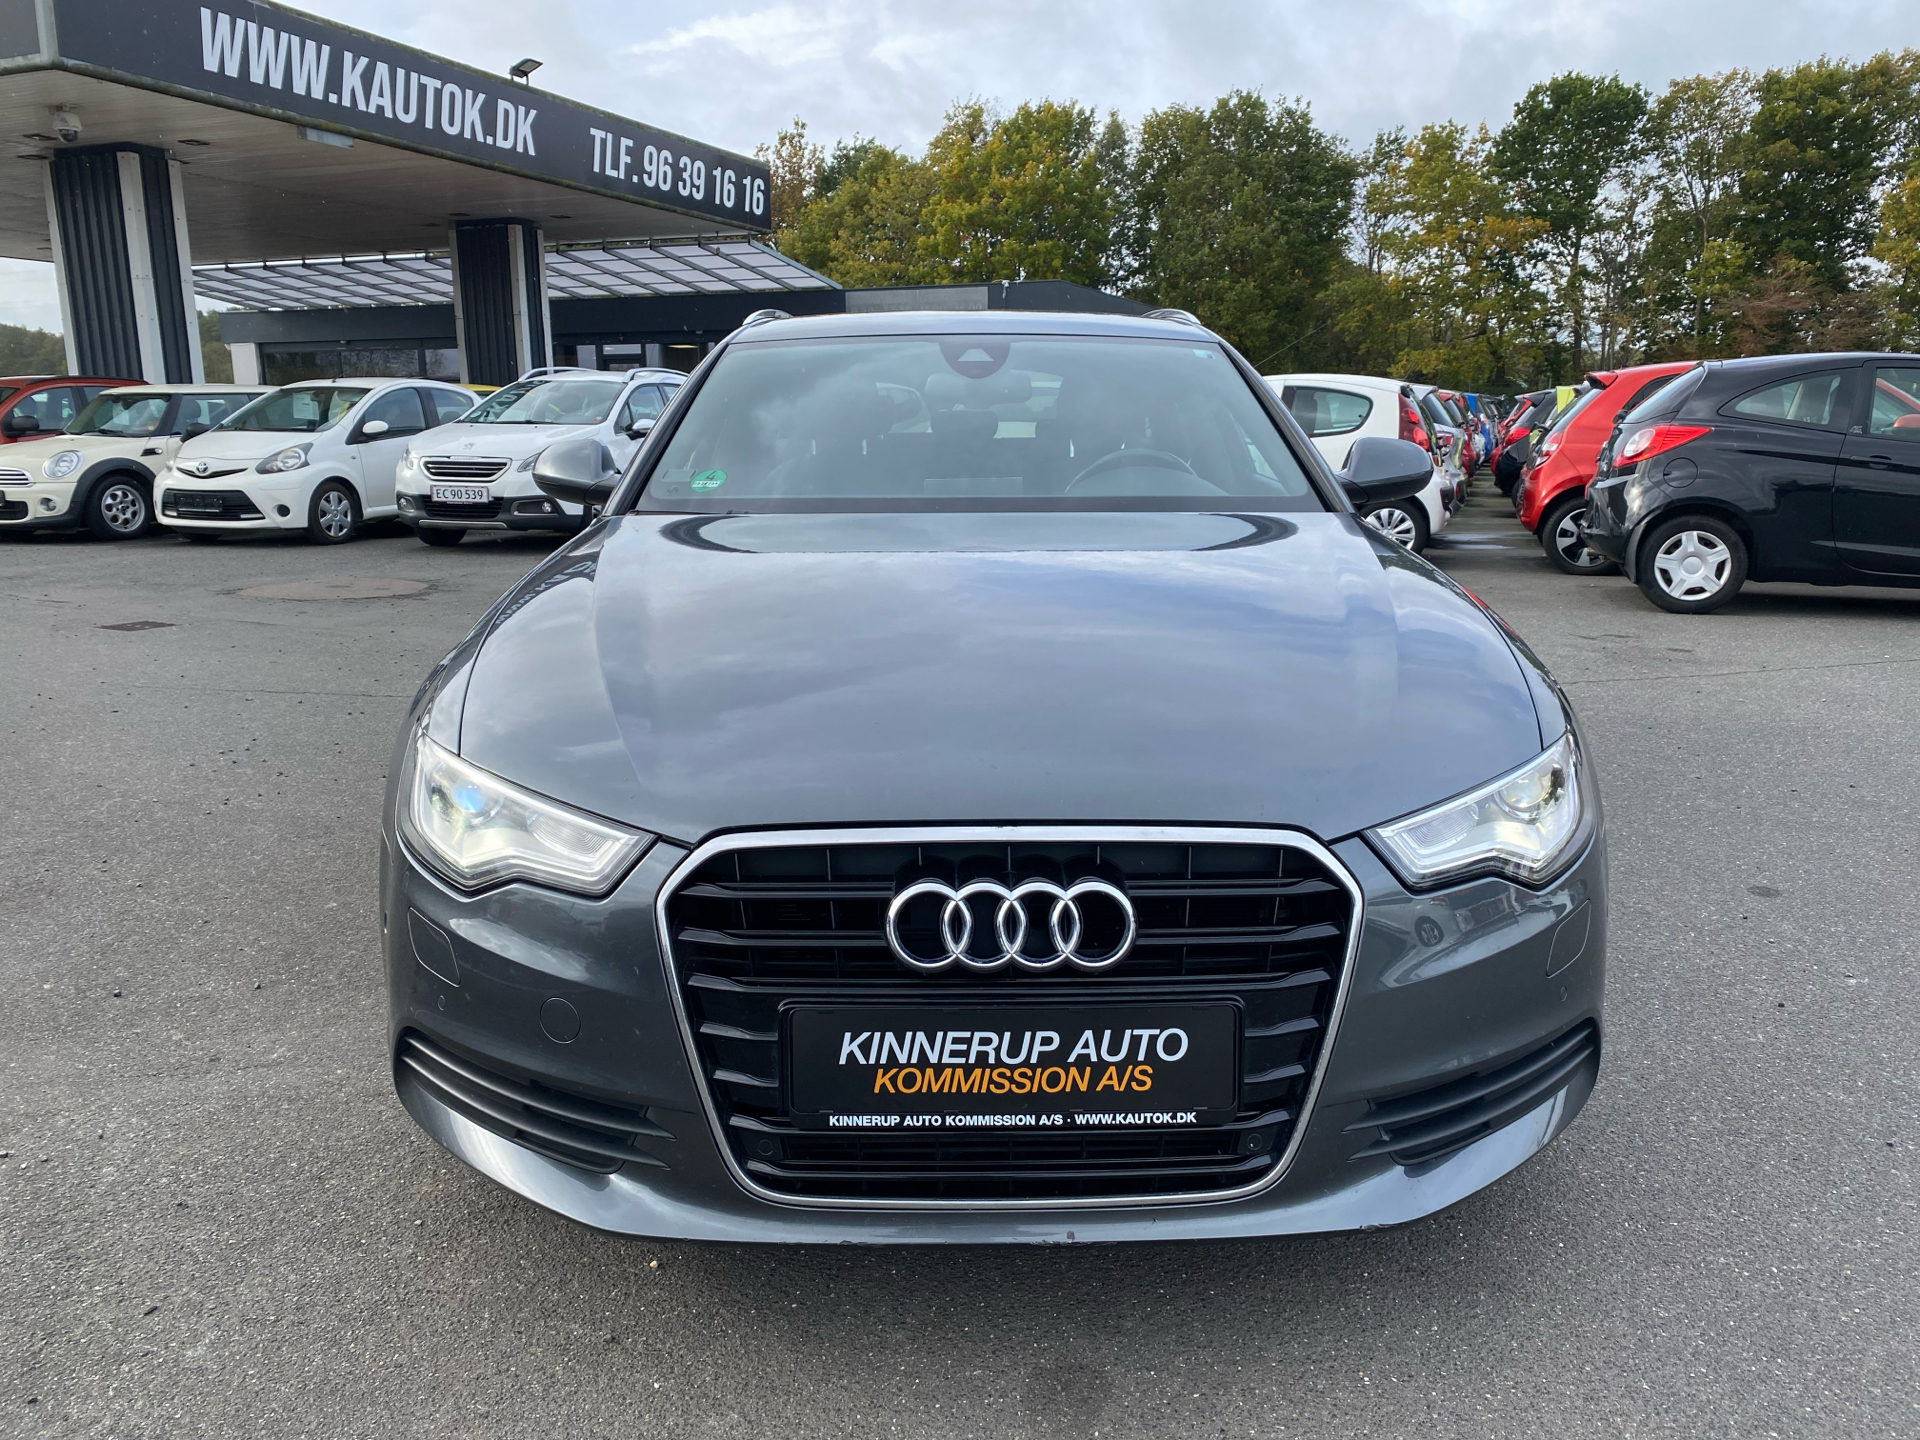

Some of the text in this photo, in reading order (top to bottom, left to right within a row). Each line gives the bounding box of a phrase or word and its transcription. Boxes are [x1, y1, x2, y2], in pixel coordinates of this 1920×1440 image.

[200, 7, 765, 215] WWW.KAUTOK.DK TLF. 96 39 16 16
[465, 489, 483, 500] 539
[838, 1027, 1189, 1065] KINNERUP AUTO
[873, 1065, 1154, 1094] KOMMISSION A/S
[829, 1112, 1197, 1127] KINNERUP AUTO KOMMISSION A/S WWW.KAUTOK.DK
